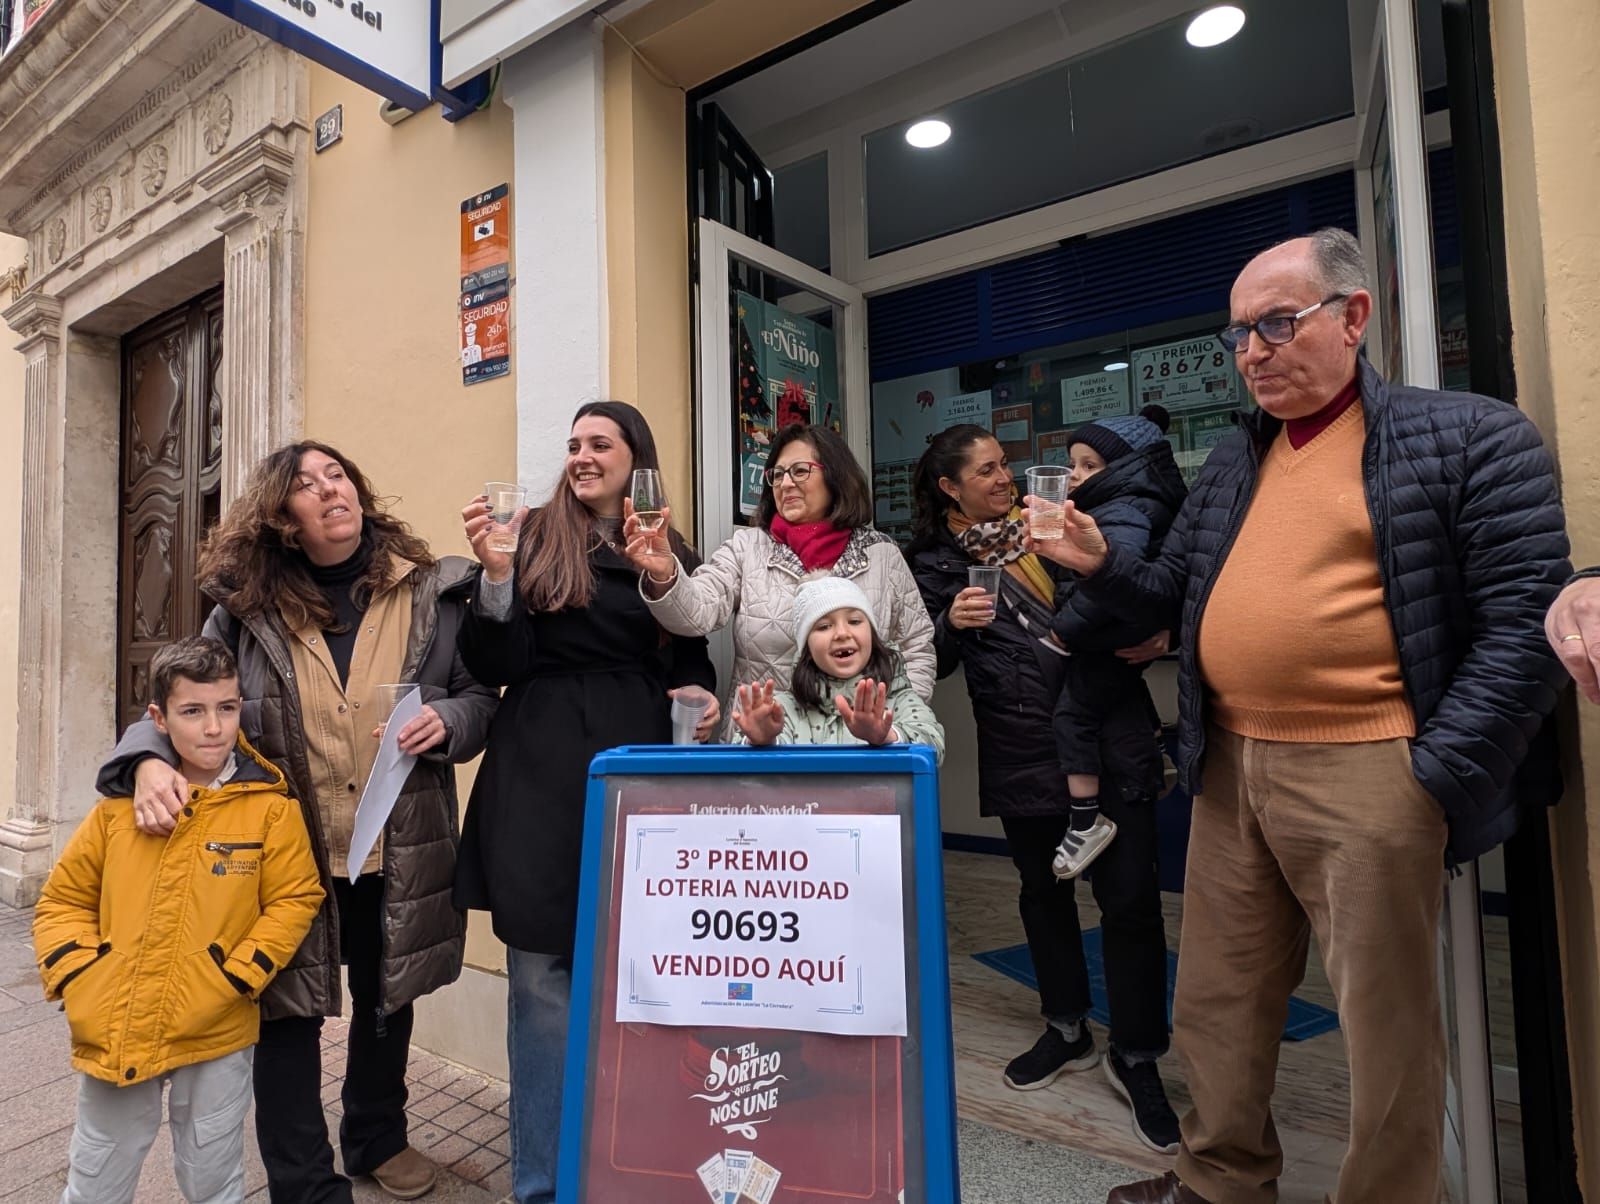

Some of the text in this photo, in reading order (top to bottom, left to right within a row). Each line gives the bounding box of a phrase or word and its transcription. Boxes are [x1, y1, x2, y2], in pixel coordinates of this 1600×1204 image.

[351, 1, 382, 32] del
[320, 119, 336, 140] 29
[467, 201, 501, 222] SEGURIDAD
[464, 301, 508, 324] SEGURIDAD
[773, 328, 820, 368] Niño
[1163, 341, 1214, 360] PREMIO
[1143, 352, 1225, 380] 28678
[1080, 377, 1106, 386] PREMIO
[740, 804, 757, 815] de
[760, 802, 819, 815] Navidad
[676, 849, 808, 872] 3º PREMIO
[645, 878, 849, 900] LOTERIA NAVIDAD
[691, 908, 800, 942] 90693
[652, 954, 846, 986] VENDIDO AQUÍ
[736, 1042, 760, 1061] EL
[704, 1045, 781, 1091] SORTEO
[734, 1083, 752, 1097] QUE
[709, 1087, 779, 1126] NOS UNE
